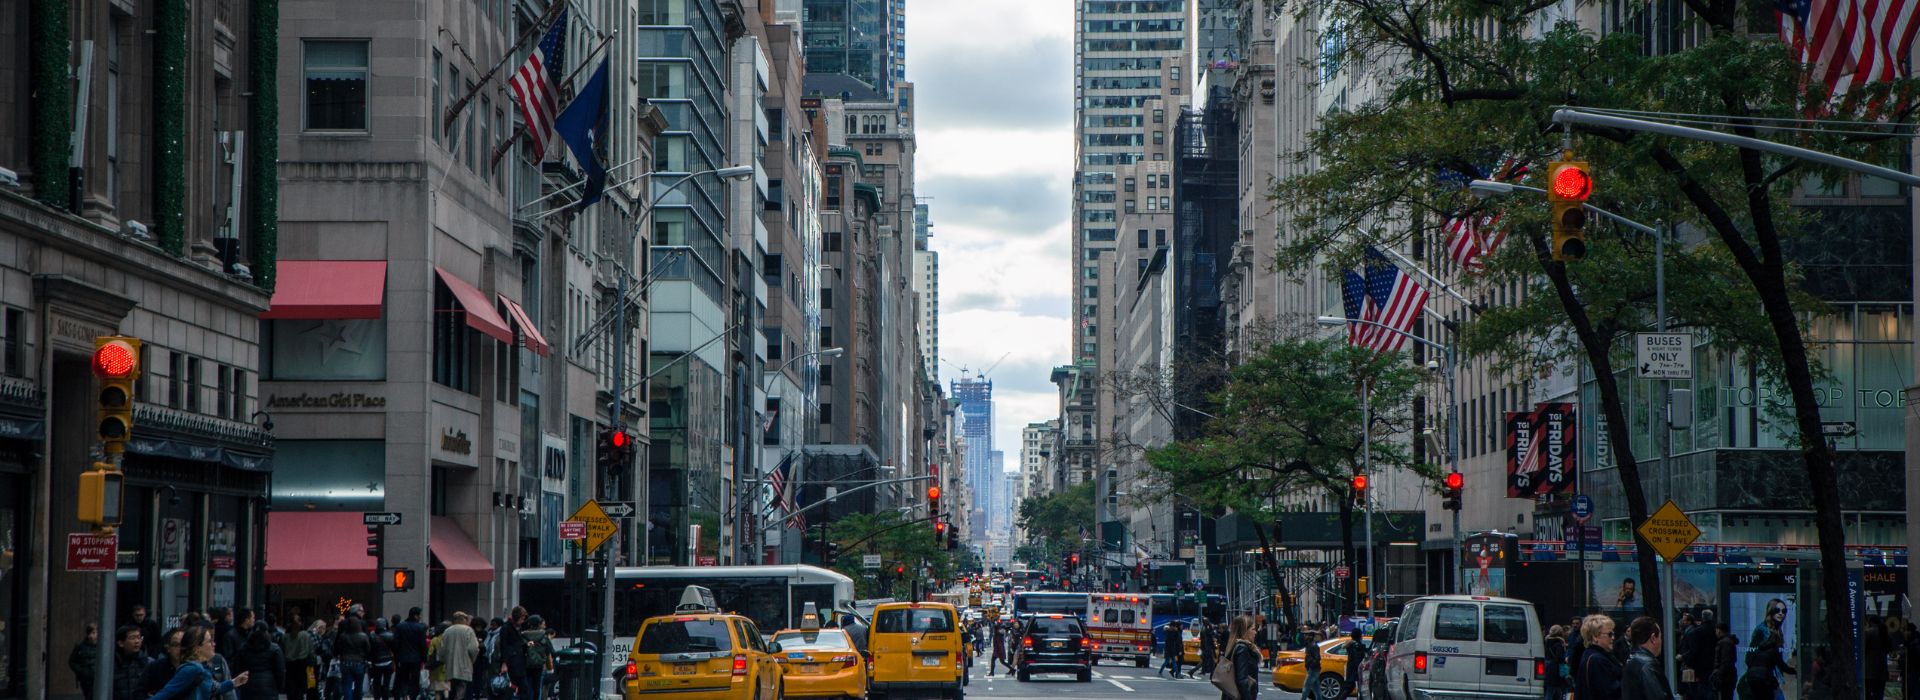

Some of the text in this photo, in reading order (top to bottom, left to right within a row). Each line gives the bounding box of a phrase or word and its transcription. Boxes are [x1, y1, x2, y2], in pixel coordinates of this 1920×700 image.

[1647, 336, 1682, 346] BUSES
[1651, 352, 1678, 362] ONLY
[266, 392, 386, 408] American Girl Place
[1836, 425, 1851, 433] WAY
[1548, 421, 1563, 483] FRIDAYS
[1651, 519, 1689, 527] RECESSED
[1648, 527, 1691, 536] CROSSWALK
[71, 537, 114, 545] NO STOPPING
[76, 547, 109, 556] ANYTIME
